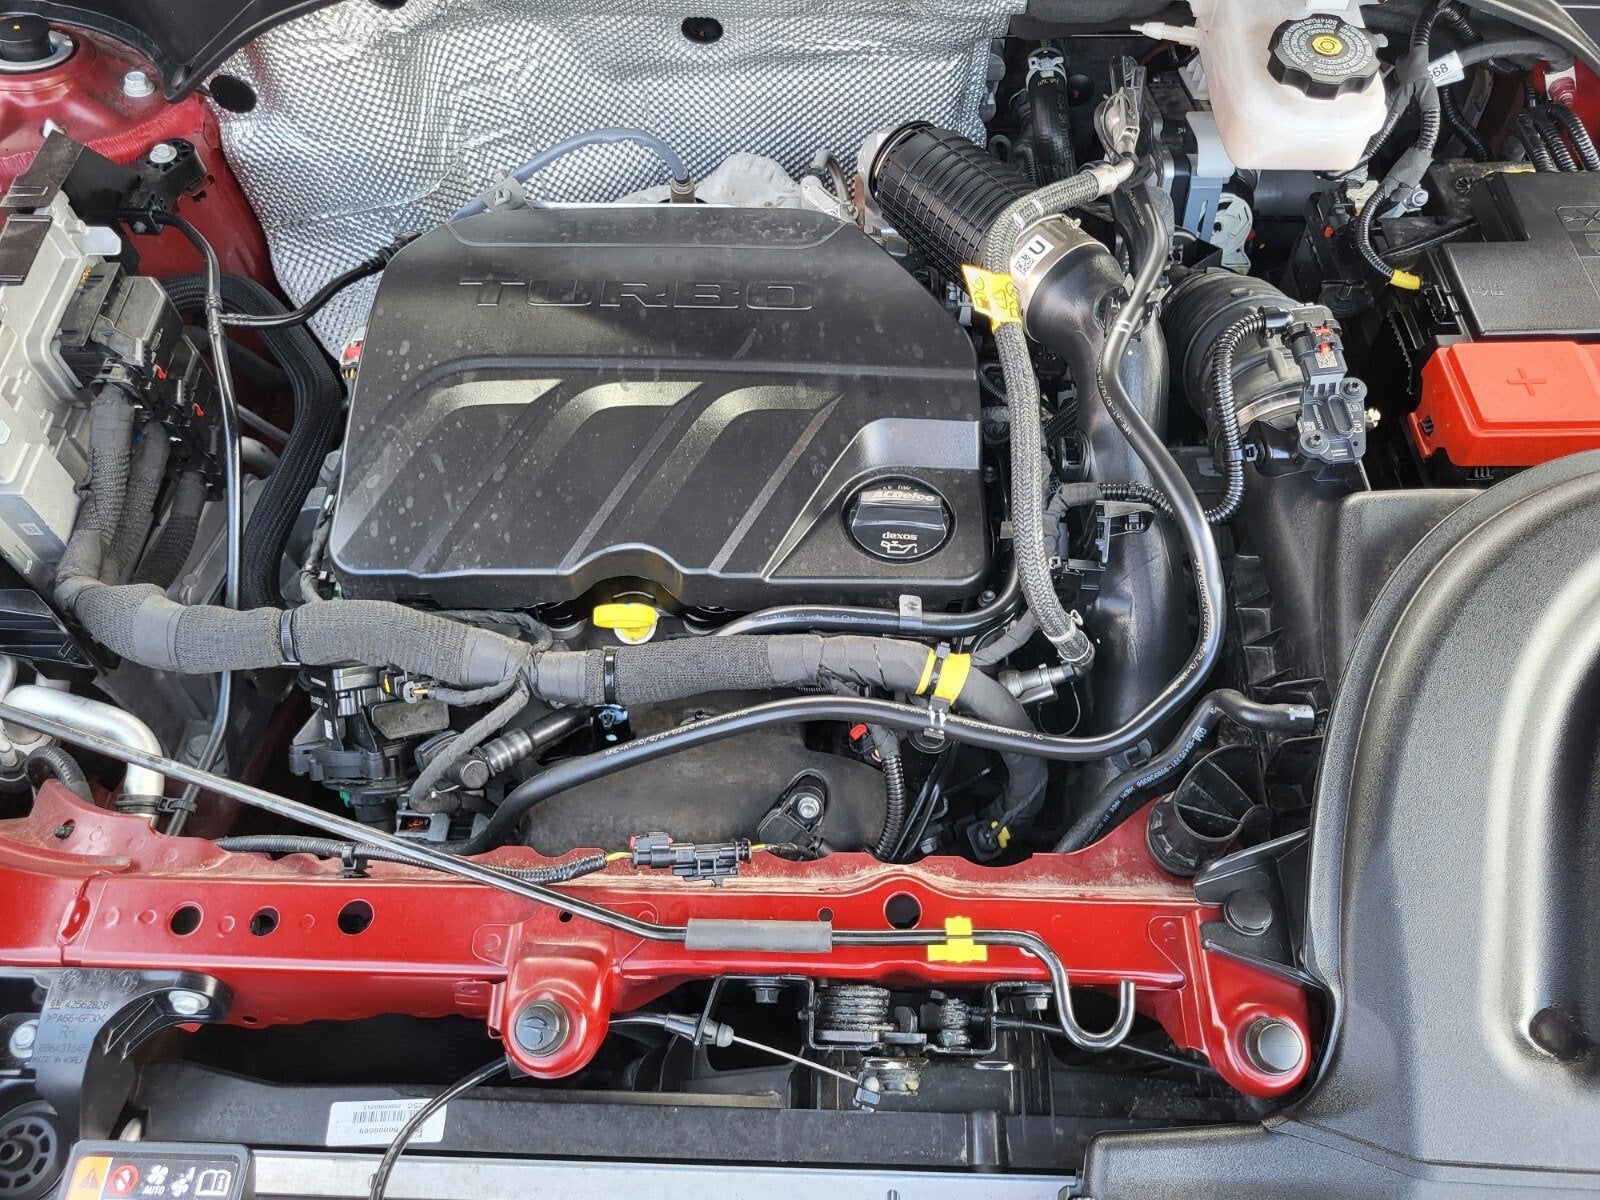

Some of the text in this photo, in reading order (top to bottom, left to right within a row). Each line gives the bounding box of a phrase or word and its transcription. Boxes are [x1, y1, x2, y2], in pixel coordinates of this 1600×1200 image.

[1028, 240, 1046, 255] U
[459, 279, 814, 310] TURBO
[872, 490, 935, 502] ACDelco
[882, 532, 918, 540] dexos
[65, 1000, 110, 1010] 42562828
[142, 1185, 165, 1196] AUTO
